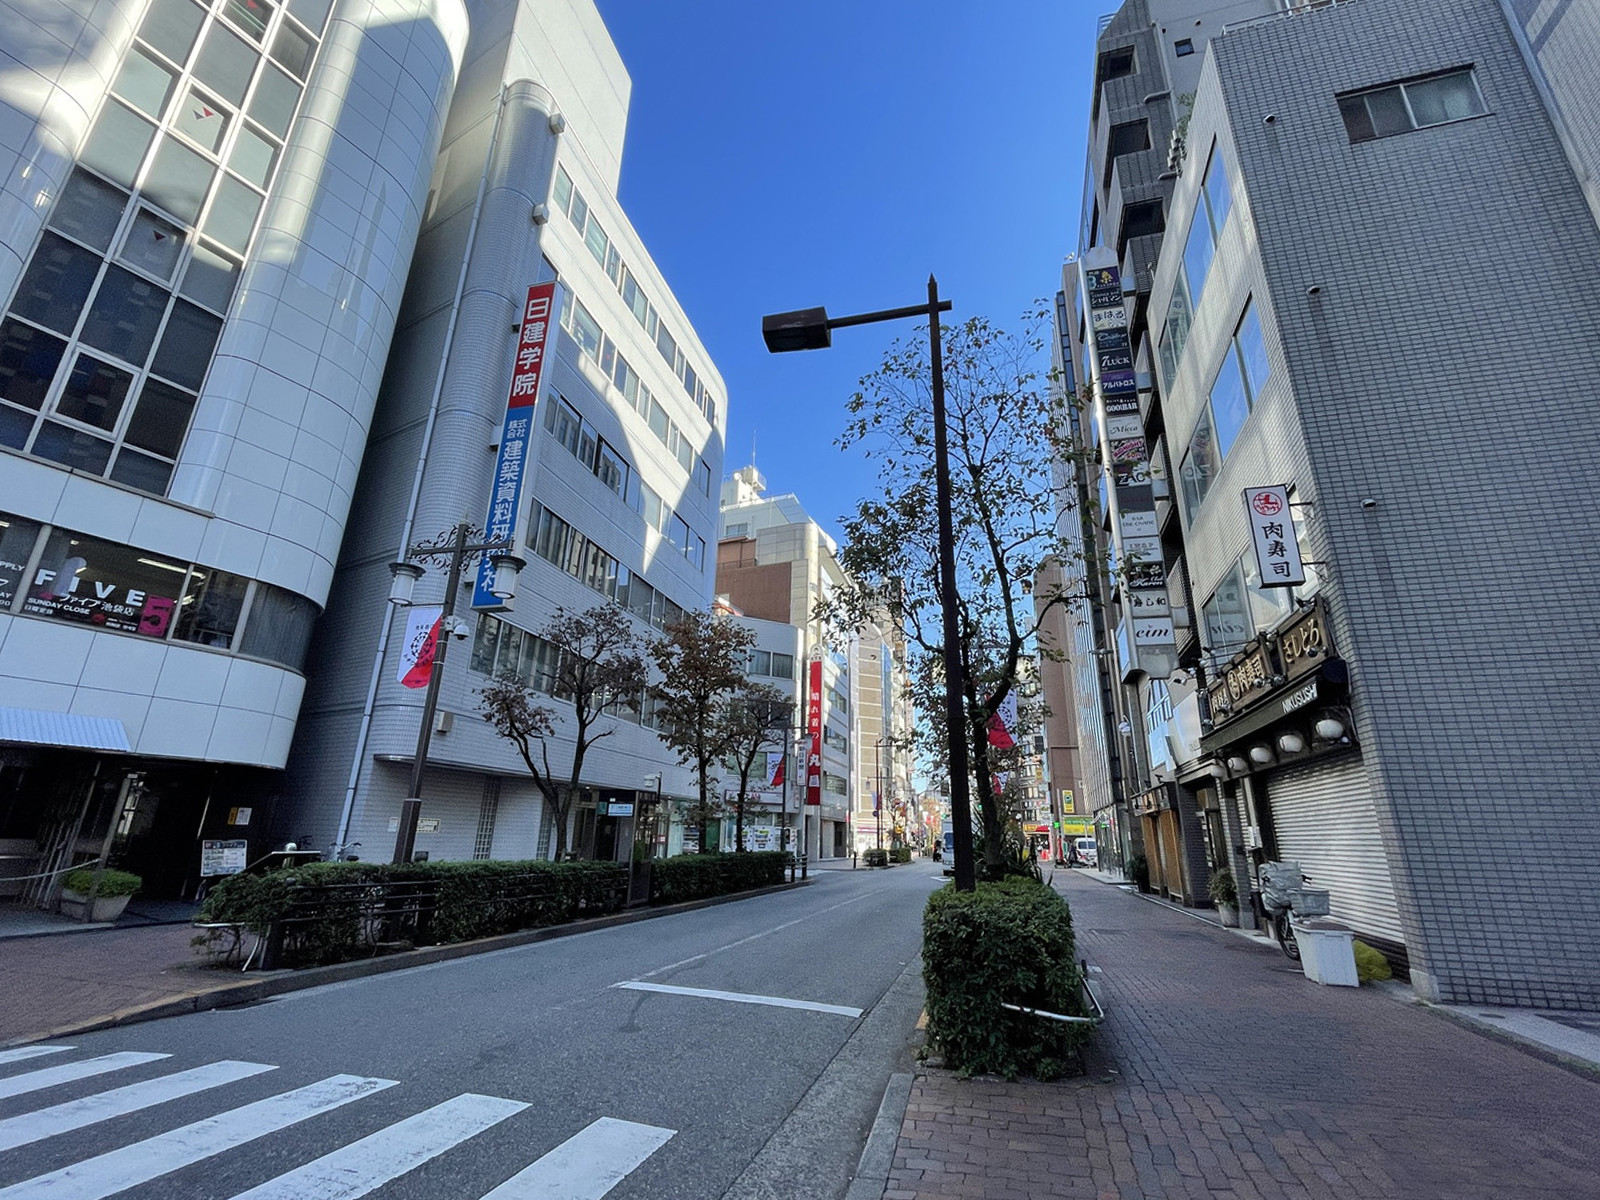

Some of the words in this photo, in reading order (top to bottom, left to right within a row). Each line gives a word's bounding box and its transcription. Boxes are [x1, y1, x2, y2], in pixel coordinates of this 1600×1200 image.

[512, 297, 550, 397] 日建学院
[1103, 379, 1135, 390] アルバトロス
[1261, 521, 1291, 578] 肉寿司
[27, 597, 62, 609] SUNDAY
[63, 604, 91, 615] CLOSE
[34, 568, 145, 608] FIVE
